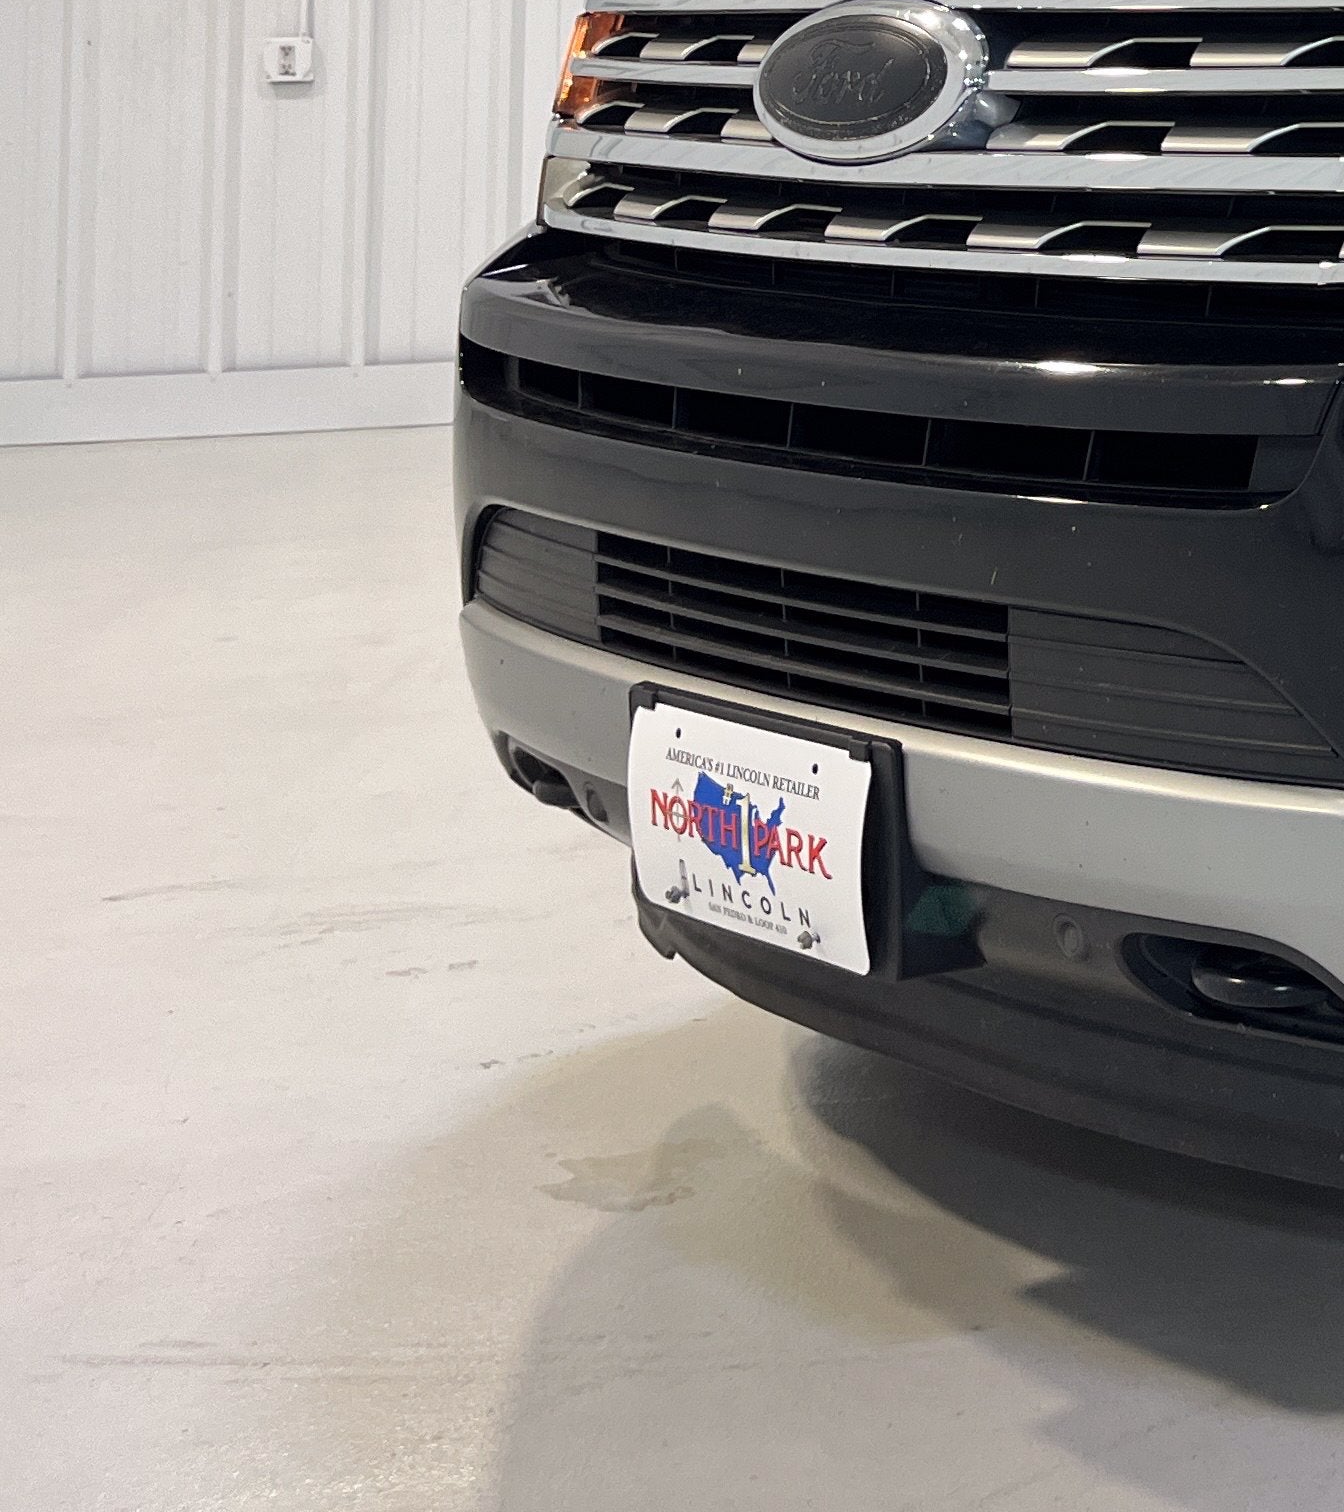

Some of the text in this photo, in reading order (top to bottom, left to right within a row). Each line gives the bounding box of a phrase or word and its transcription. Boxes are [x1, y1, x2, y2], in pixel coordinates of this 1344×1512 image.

[791, 38, 896, 106] Ford
[665, 747, 820, 800] AMERICA'S #1 LINCOLN RETAILER
[650, 788, 833, 880] NORTH PARK
[692, 873, 811, 928] LINCOLN
